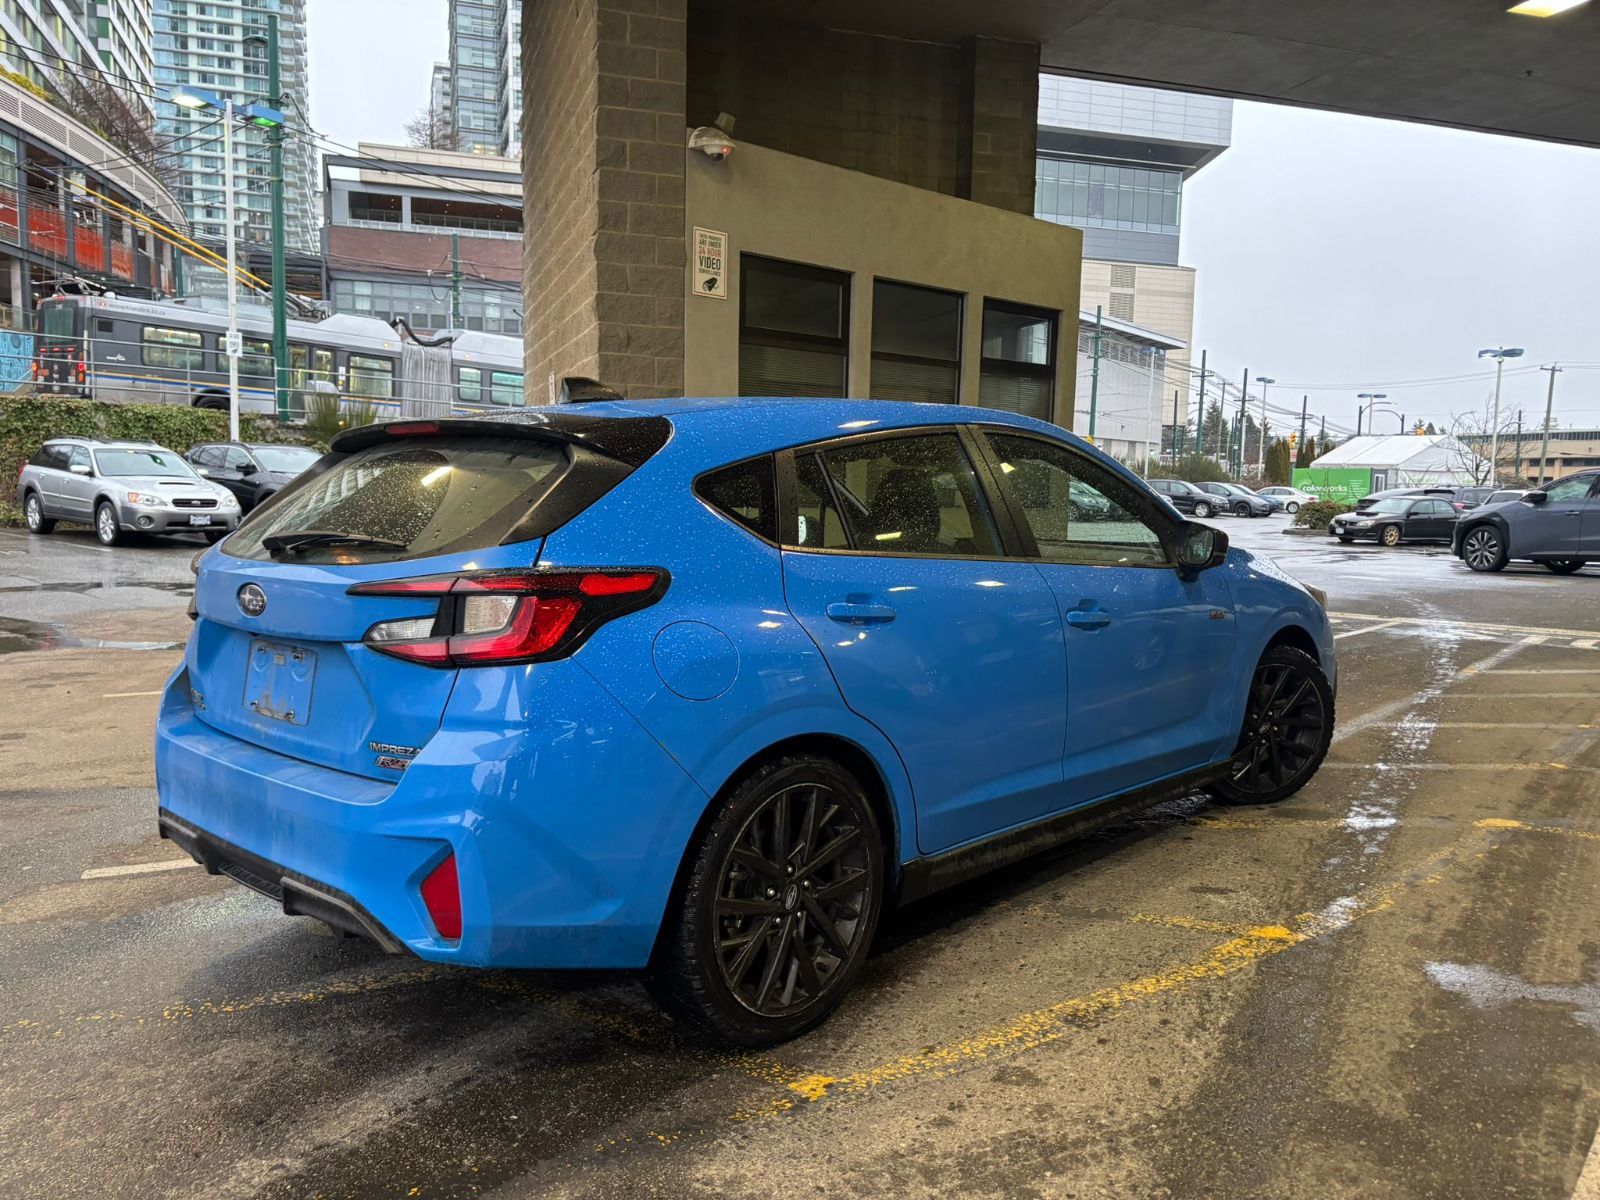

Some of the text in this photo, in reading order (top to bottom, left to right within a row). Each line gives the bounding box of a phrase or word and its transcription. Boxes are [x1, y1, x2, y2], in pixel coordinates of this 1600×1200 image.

[698, 246, 721, 257] 24 HOUR
[698, 255, 721, 270] VIDEO
[369, 741, 421, 756] IMPREZA
